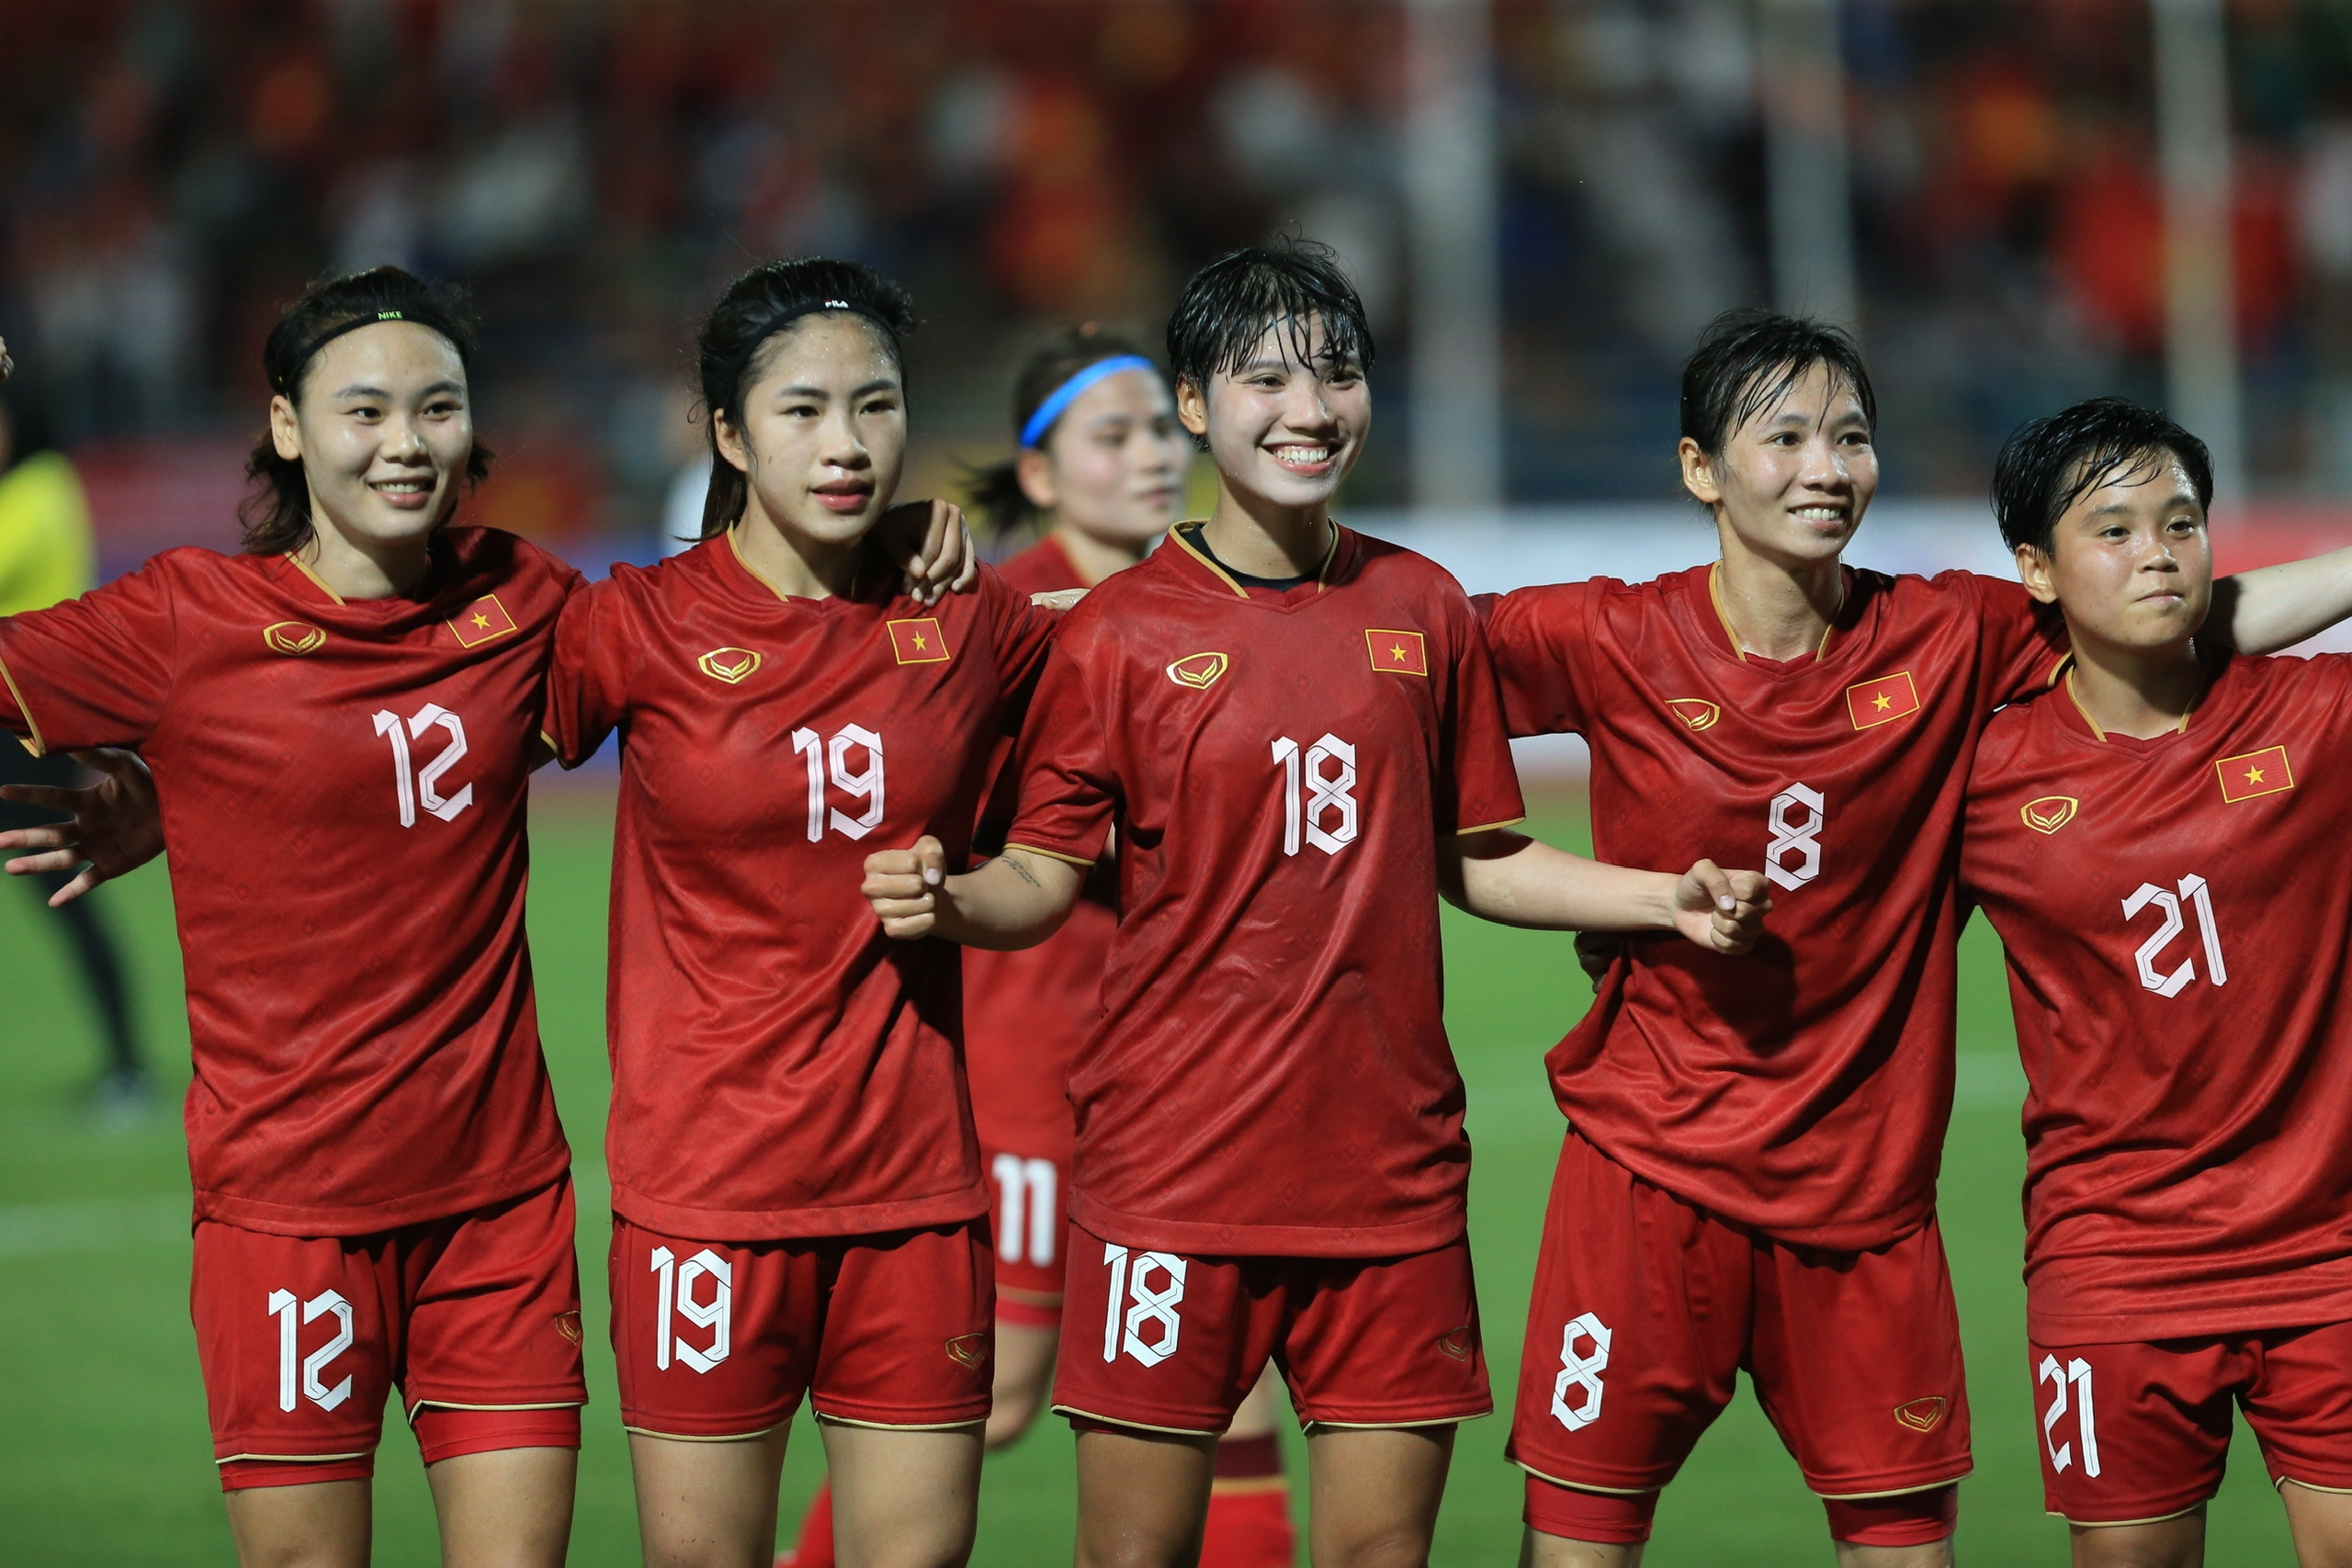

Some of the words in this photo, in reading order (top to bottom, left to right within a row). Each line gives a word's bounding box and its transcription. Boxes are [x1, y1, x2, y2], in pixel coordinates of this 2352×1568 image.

[378, 310, 403, 321] NIKE
[824, 299, 850, 309] FILA
[371, 702, 473, 829] 12
[791, 722, 885, 843] 19
[1271, 732, 1358, 857] 18
[1764, 781, 1825, 892] 8
[2120, 873, 2228, 998] 21
[992, 1153, 1057, 1267] 11
[267, 1288, 354, 1414] 12
[650, 1246, 732, 1375] 19
[1102, 1242, 1188, 1370] 18
[1550, 1311, 1613, 1433] 8
[2038, 1353, 2101, 1480] 21
